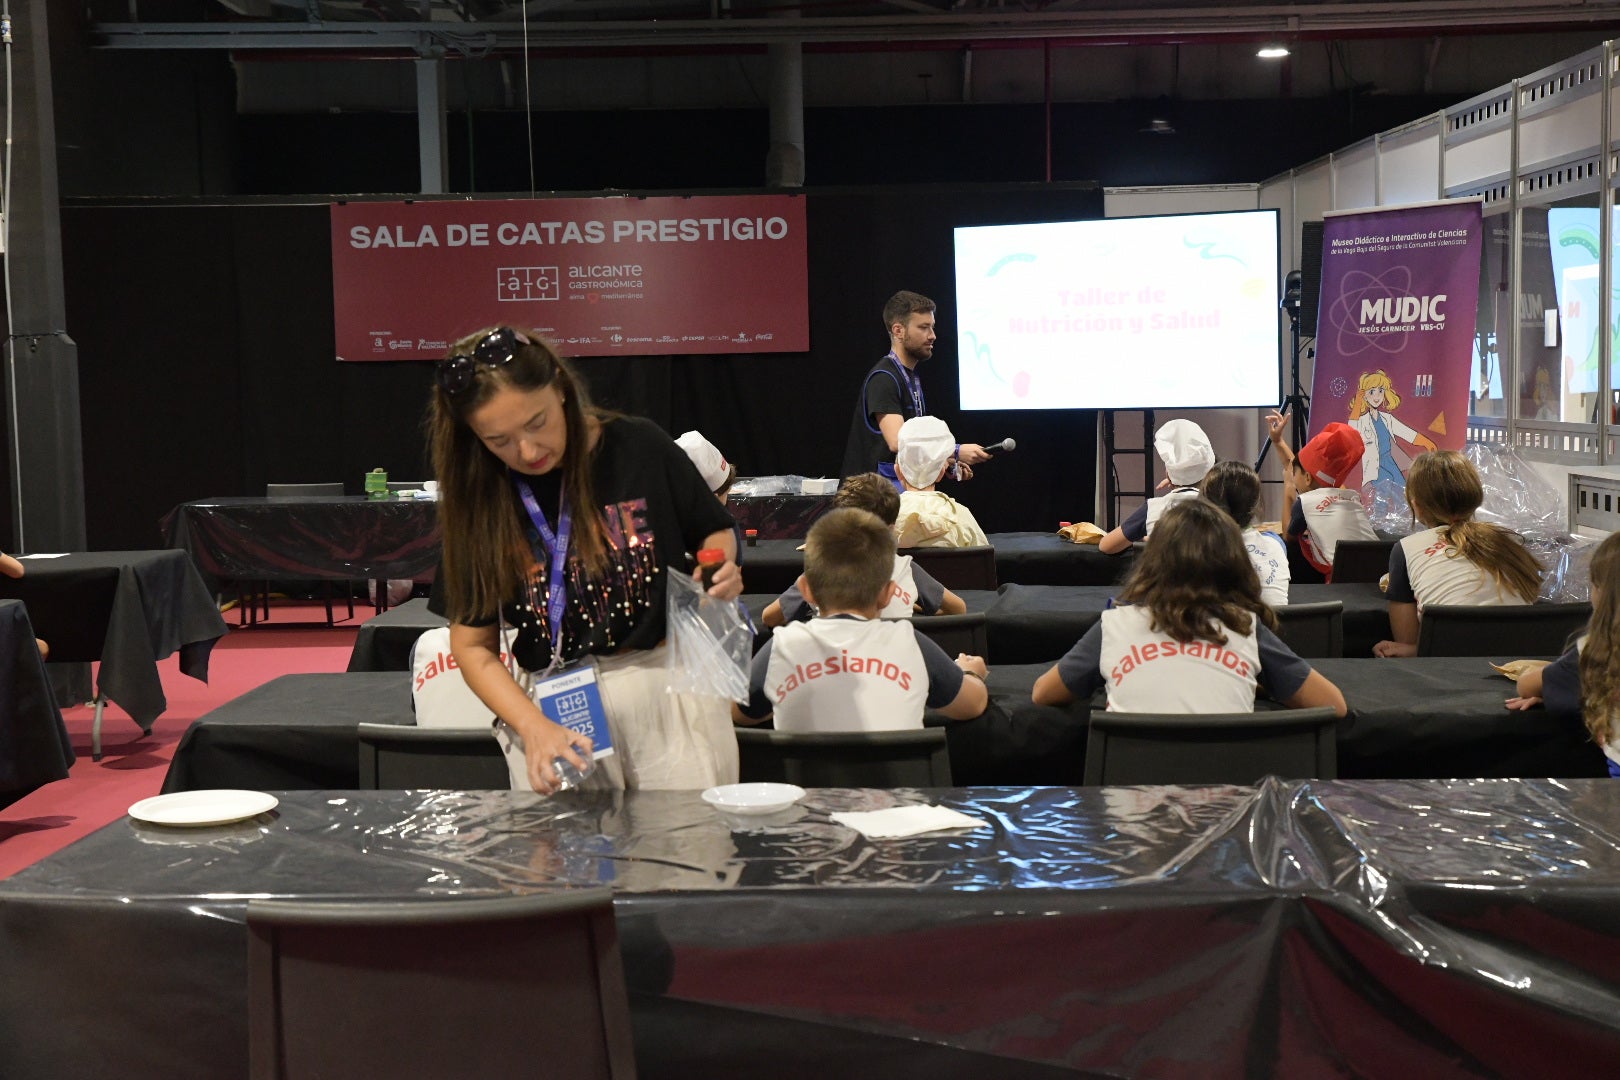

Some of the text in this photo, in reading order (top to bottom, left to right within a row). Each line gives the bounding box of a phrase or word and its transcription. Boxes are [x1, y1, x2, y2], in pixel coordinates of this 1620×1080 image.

[350, 216, 788, 249] SALA DE CATAS PRESTIGIO
[1331, 239, 1354, 247] Museo
[1354, 235, 1385, 245] Didáctico
[1391, 232, 1427, 241] Interactivo
[1428, 231, 1437, 239] de
[1438, 228, 1468, 238] Ciencias
[1058, 286, 1167, 306] Taller de
[1009, 309, 1220, 334] Nutrición y Salud
[1360, 294, 1448, 325] MUDIC
[1358, 322, 1445, 333] JESÚS CARNICER VBS-CV
[776, 649, 912, 704] salesianos
